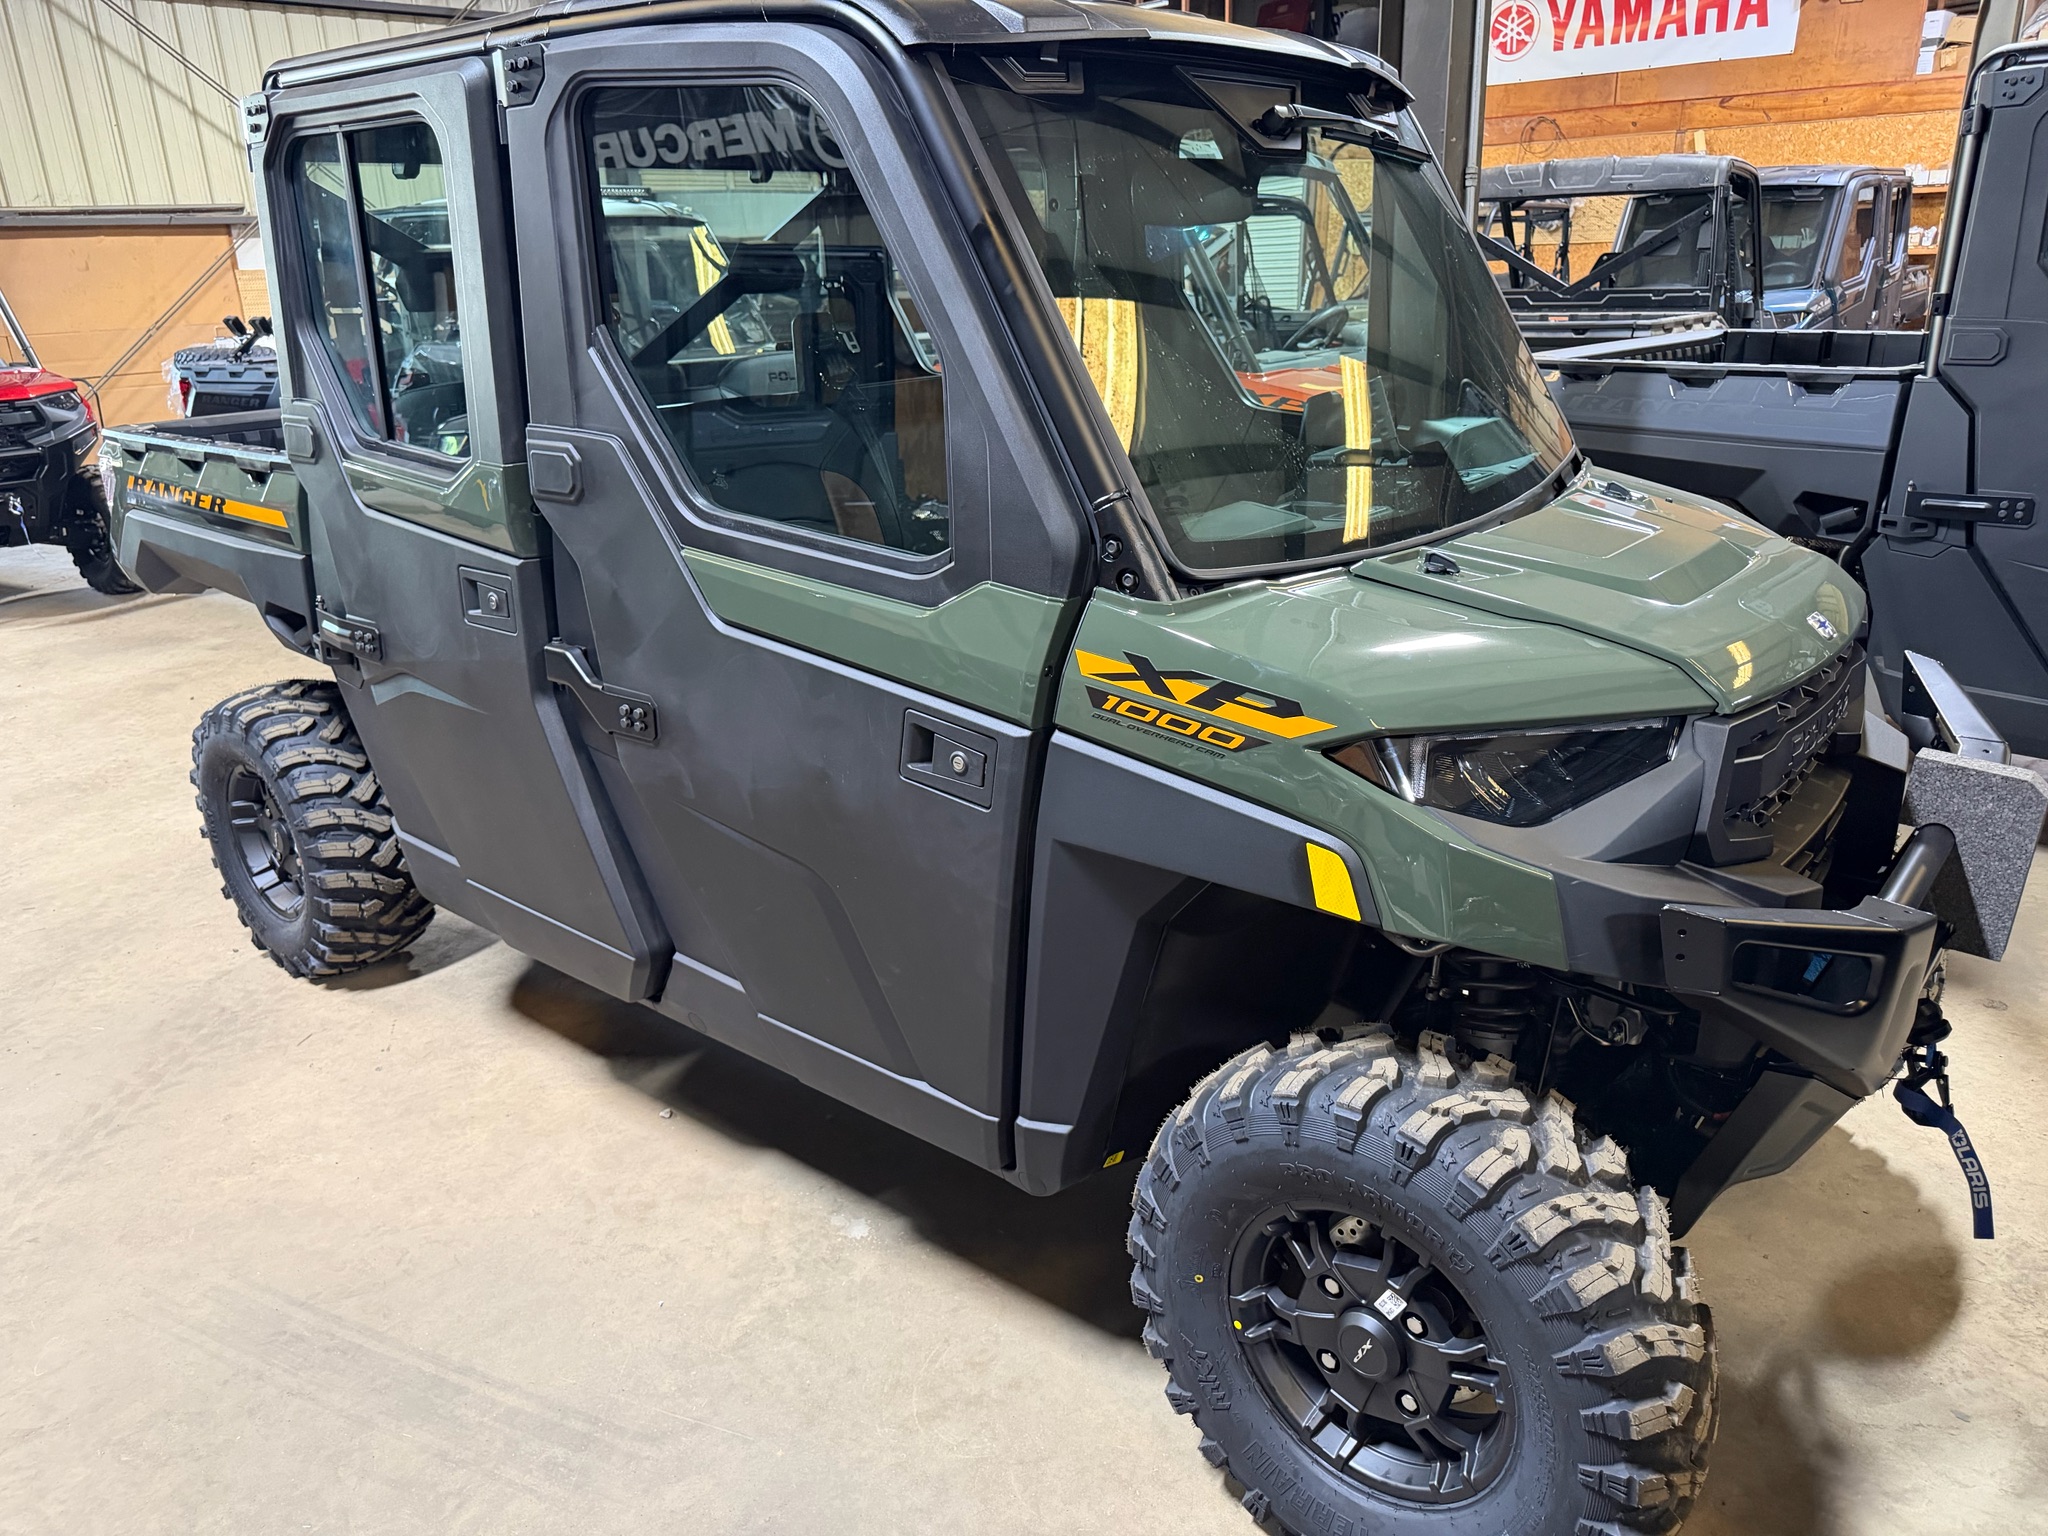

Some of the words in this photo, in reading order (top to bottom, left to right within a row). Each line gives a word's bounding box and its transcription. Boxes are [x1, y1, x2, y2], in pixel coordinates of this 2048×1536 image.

[1547, 0, 1769, 52] YAMAHA
[132, 475, 227, 515] RANGER
[1086, 649, 1306, 719] XP
[1091, 712, 1126, 728] DUAL
[1126, 723, 1195, 750] OVERHEAD
[1195, 745, 1227, 760] CAM
[1101, 694, 1247, 750] 1000
